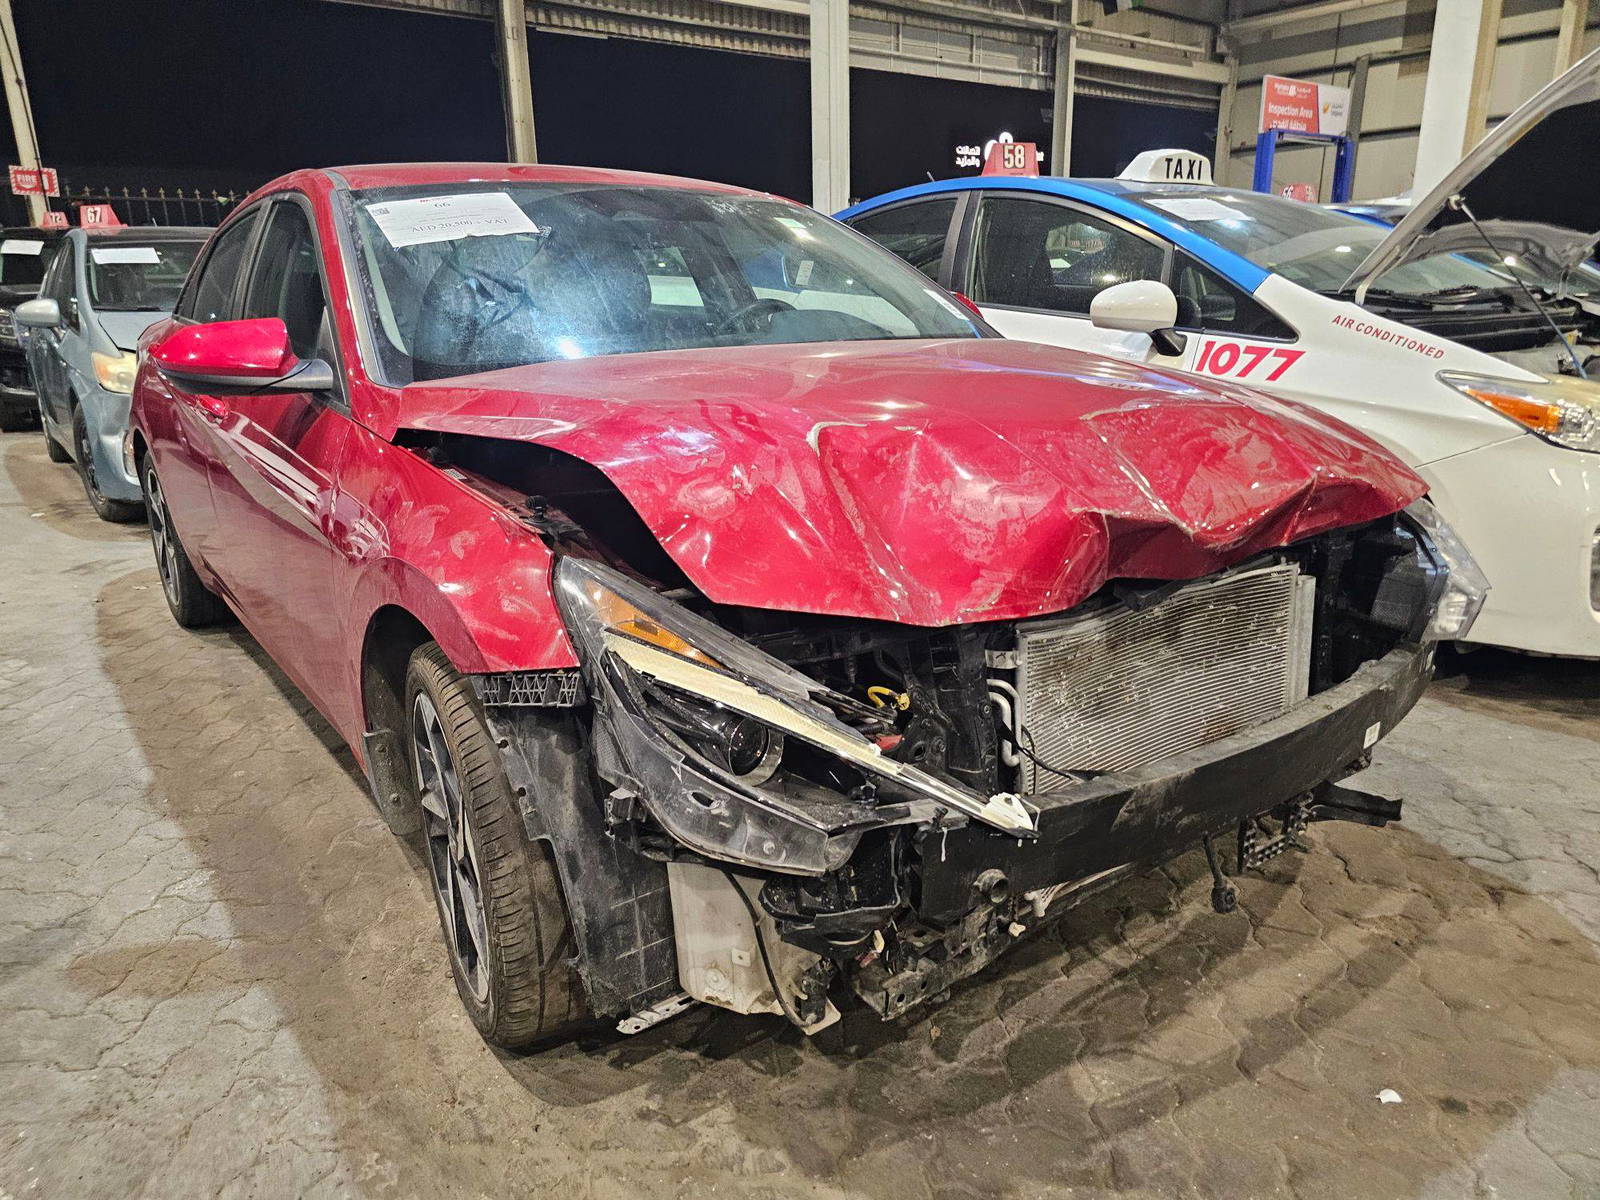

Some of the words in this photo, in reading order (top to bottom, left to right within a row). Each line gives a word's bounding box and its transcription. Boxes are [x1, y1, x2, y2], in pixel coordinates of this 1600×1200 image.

[1268, 102, 1299, 117] Inspection
[1299, 106, 1313, 119] Area
[1003, 144, 1025, 169] 58
[1164, 157, 1203, 180] TAXI
[16, 174, 37, 184] FIRE
[50, 212, 62, 223] 72
[87, 207, 102, 223] 67
[1332, 314, 1355, 329] AIR
[1355, 322, 1445, 360] CONDITIONED
[1195, 340, 1306, 382] 1077
